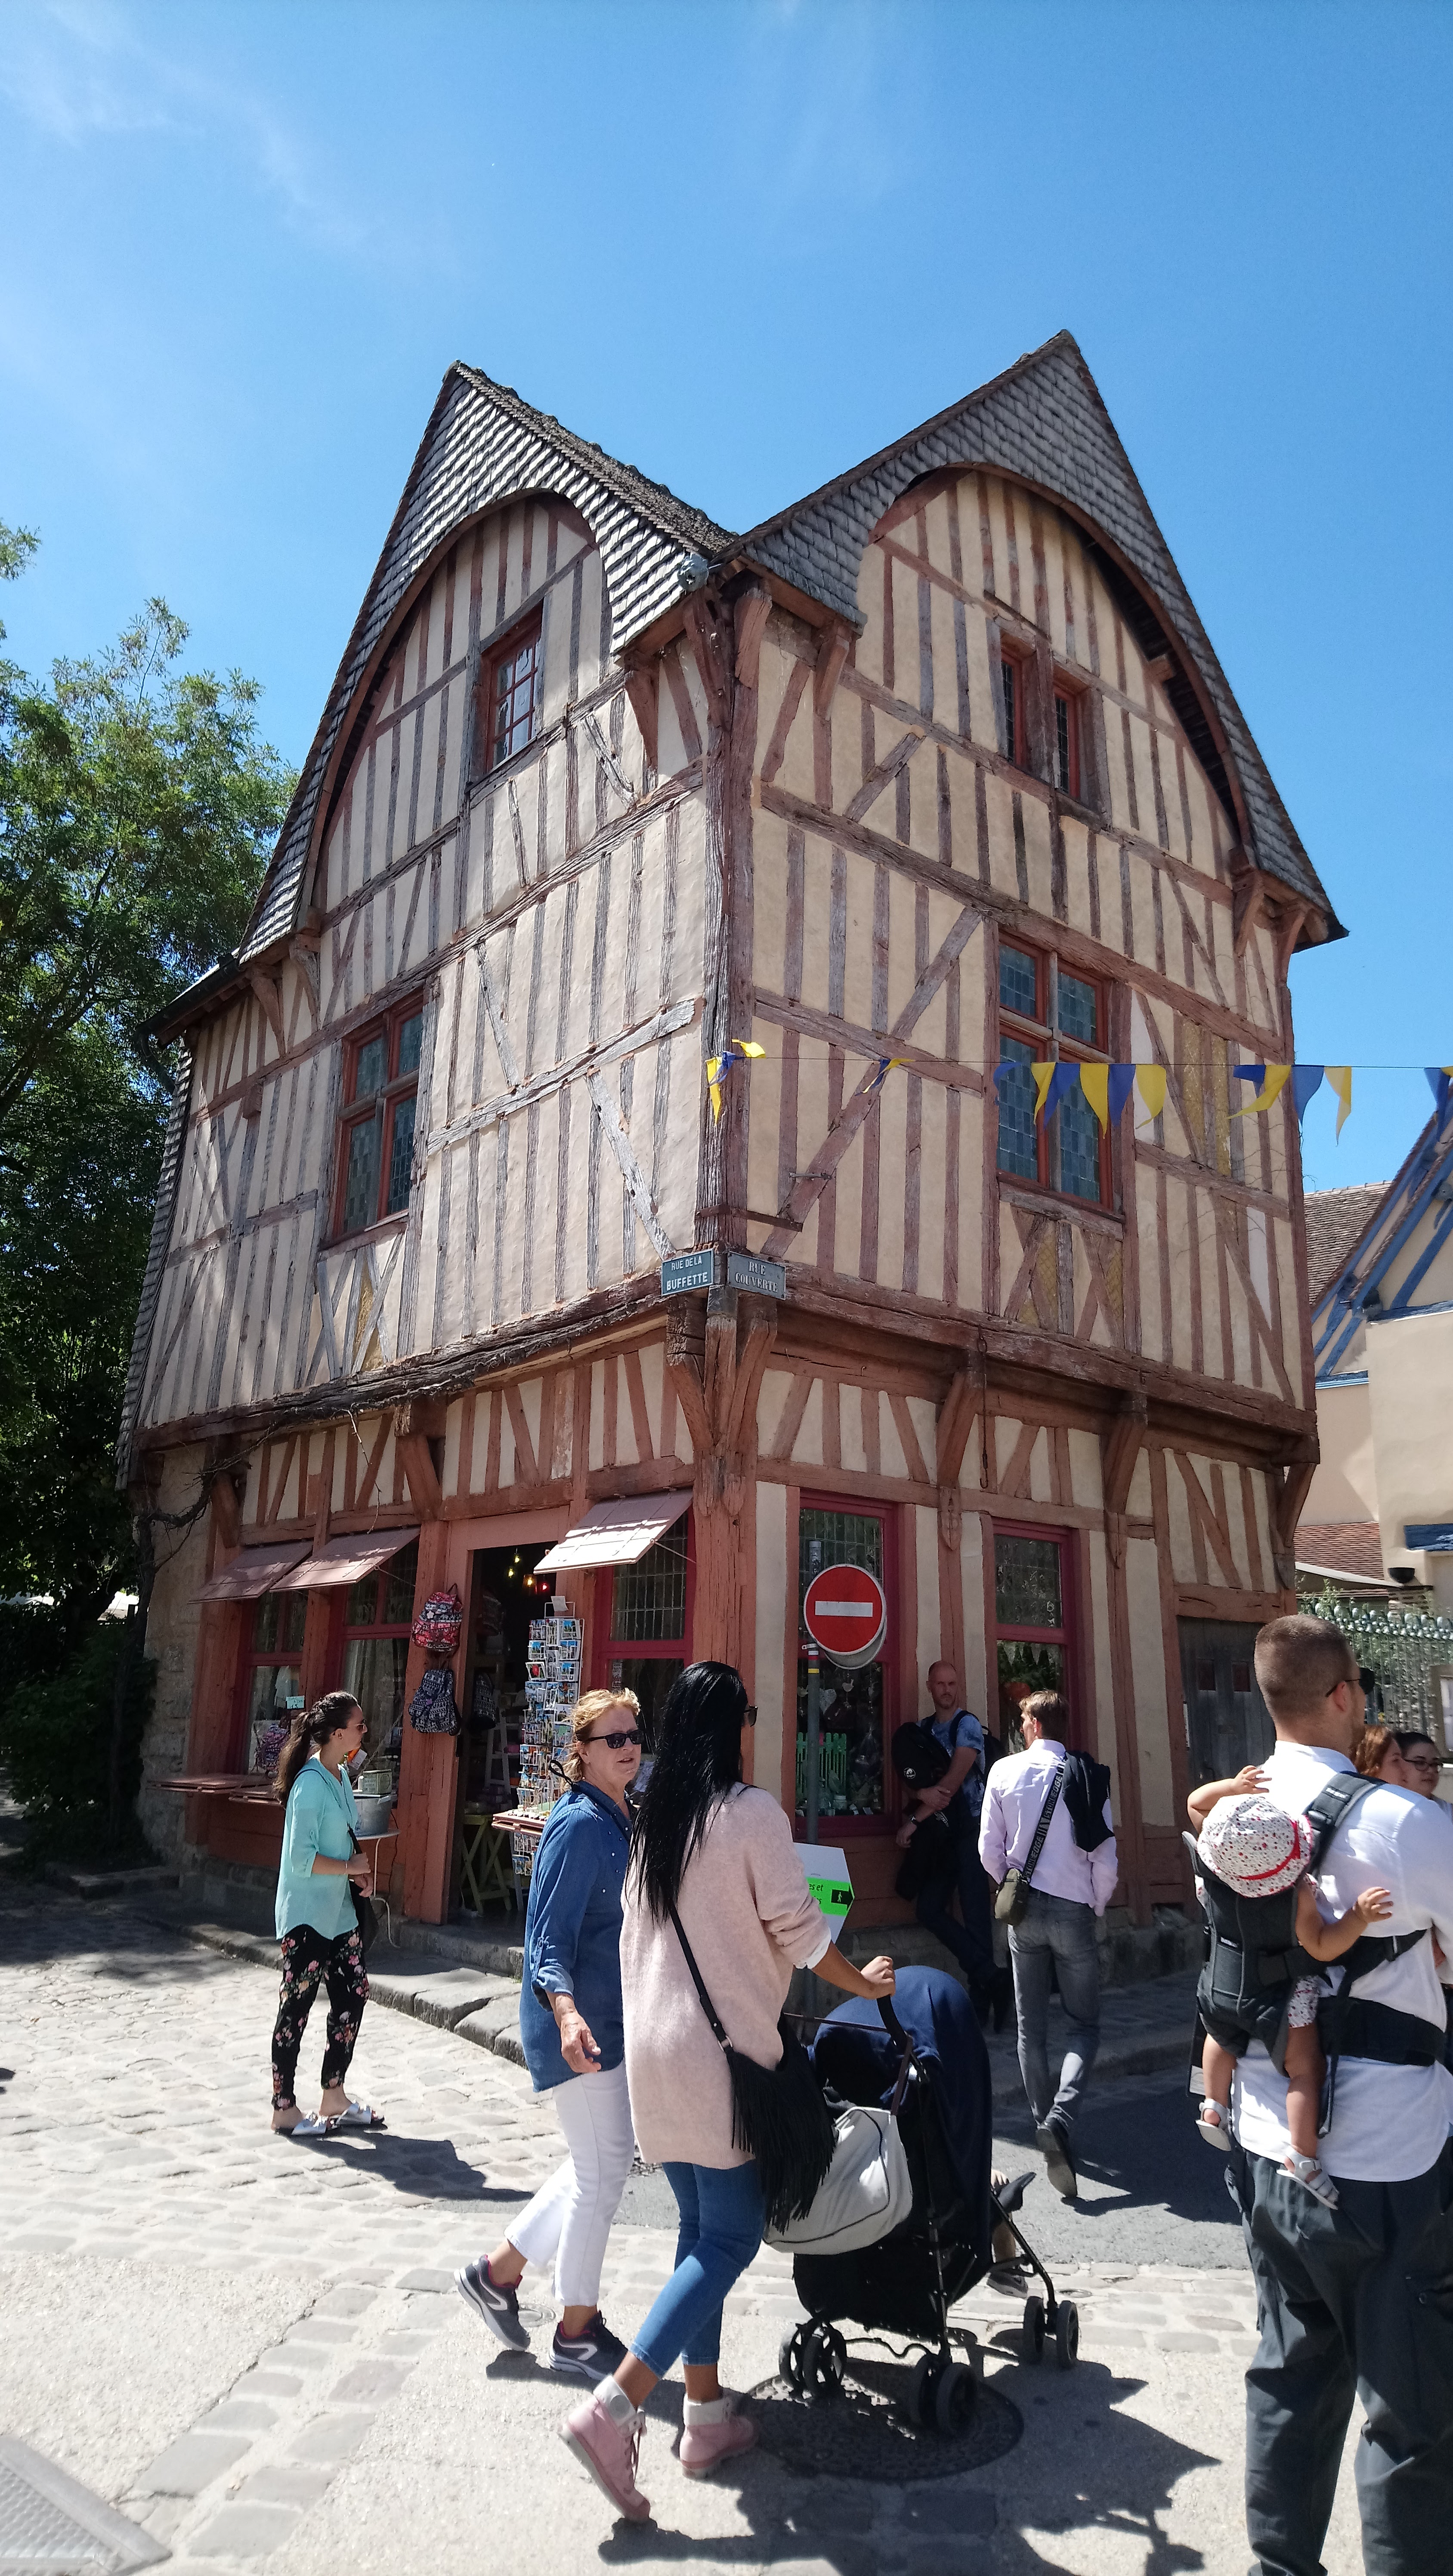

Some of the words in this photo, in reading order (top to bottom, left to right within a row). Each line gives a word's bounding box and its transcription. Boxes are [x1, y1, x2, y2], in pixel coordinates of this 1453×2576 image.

[671, 1260, 683, 1271] RUE
[685, 1258, 693, 1268] DE
[694, 1256, 702, 1265] LA
[749, 1261, 766, 1275] RUE
[667, 1272, 708, 1291] BUFFETTE
[735, 1273, 778, 1292] COUVERTE
